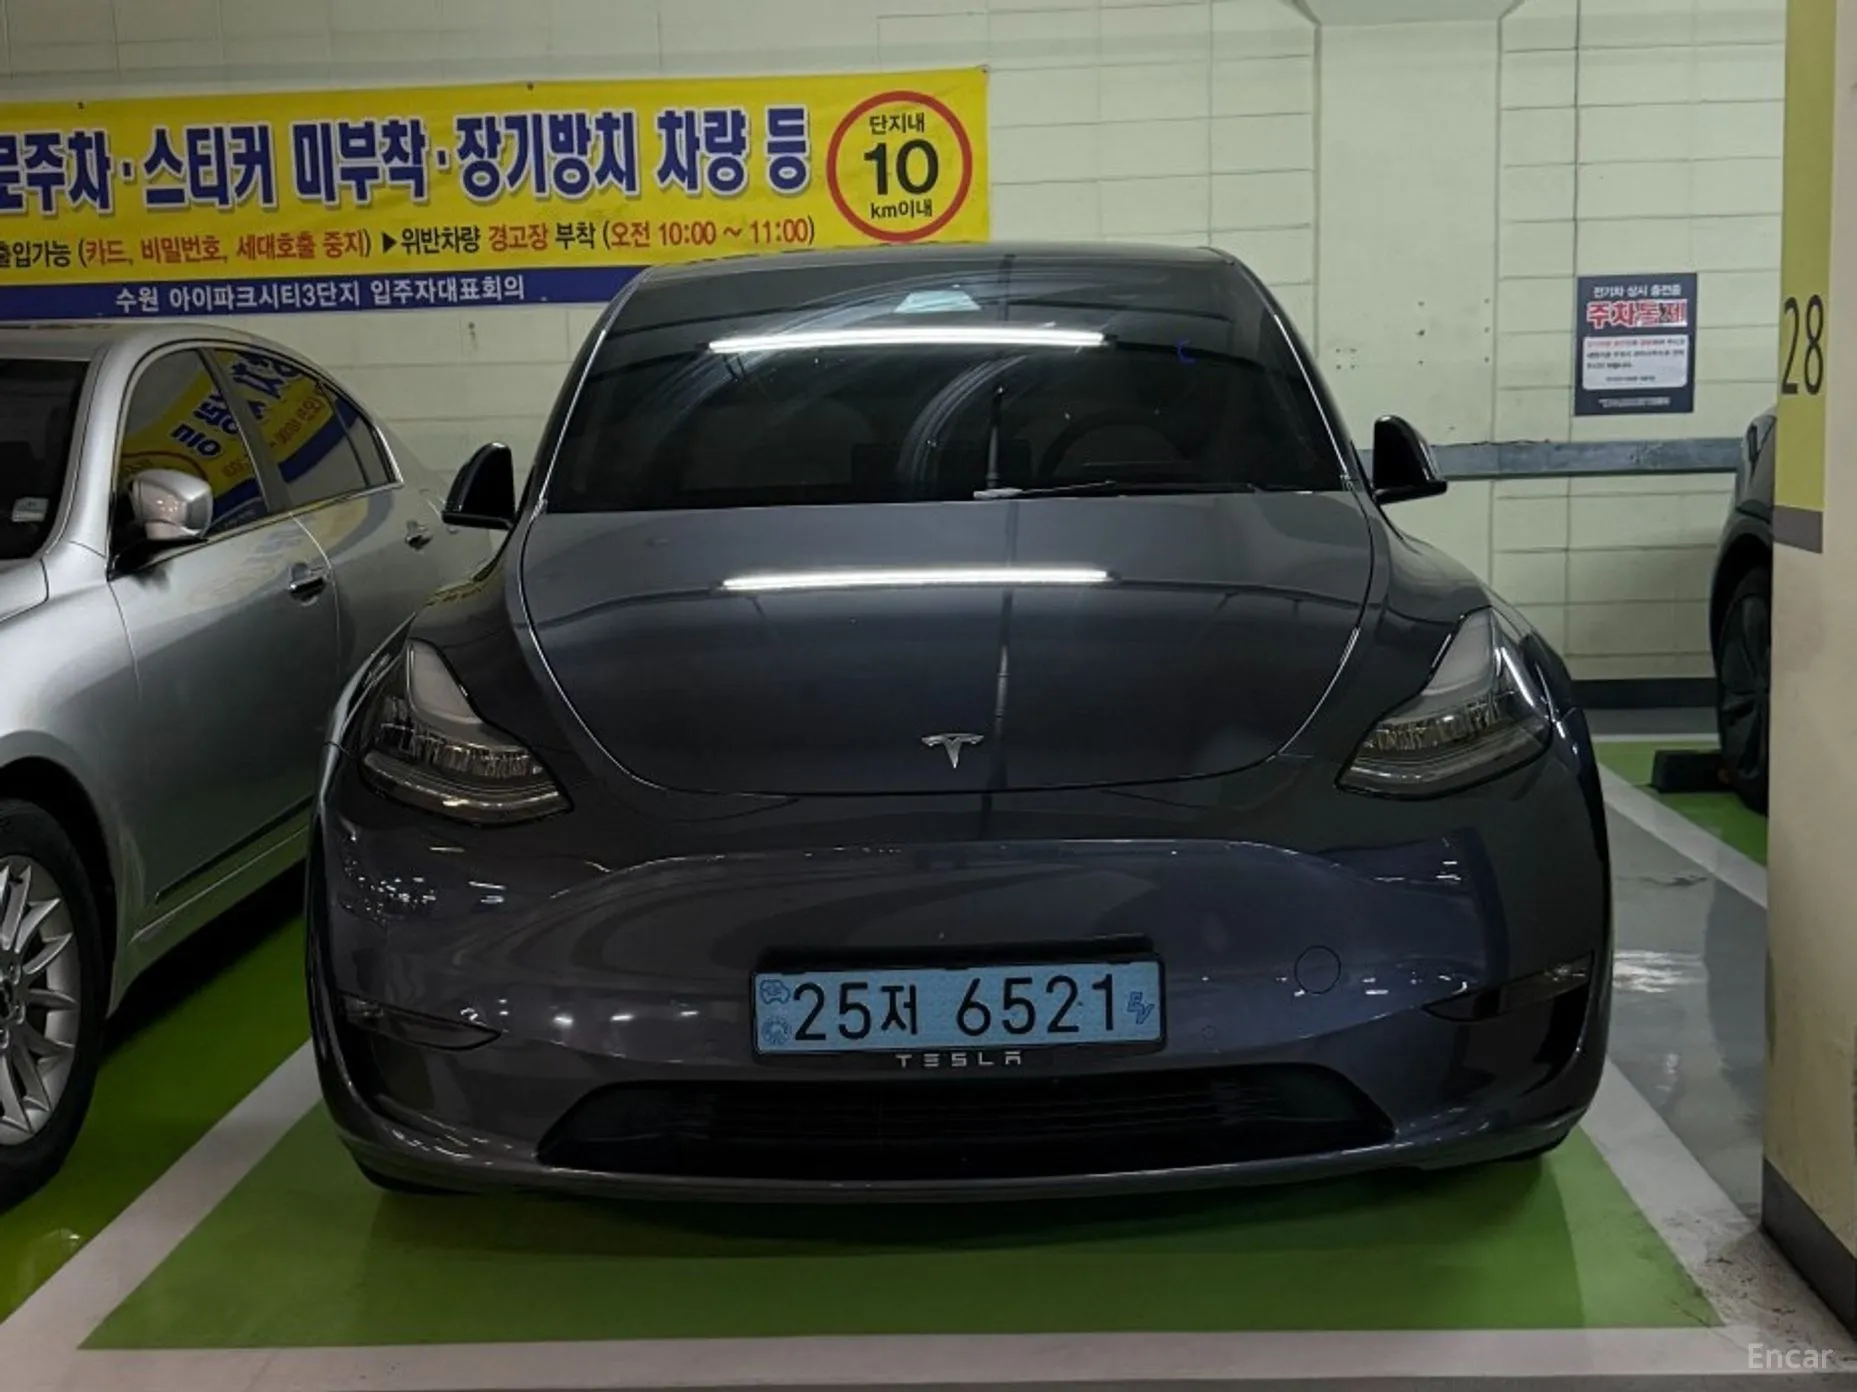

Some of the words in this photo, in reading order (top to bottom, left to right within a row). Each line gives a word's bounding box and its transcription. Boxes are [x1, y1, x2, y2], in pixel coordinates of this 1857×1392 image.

[870, 112, 925, 135] 단지내
[657, 106, 749, 196] 차량
[765, 105, 811, 193] 등
[864, 138, 939, 196] 10
[871, 199, 933, 218] km이내
[141, 235, 228, 264] 비밀번호,
[236, 230, 316, 260] 세대호출
[323, 228, 371, 258] 중지)
[488, 222, 548, 251] 경고장
[555, 221, 596, 249] 부착
[603, 220, 650, 249] (오전
[659, 221, 716, 246] 10:00
[751, 215, 815, 247] 11:00)
[116, 287, 159, 313] 수원
[169, 279, 360, 312] 아이파크시티3단지
[371, 275, 525, 305] 입주자대표회의
[1782, 295, 1824, 395] 28
[794, 982, 918, 1041] 25저
[956, 974, 1114, 1037] 6521
[897, 1051, 1022, 1068] TESLA
